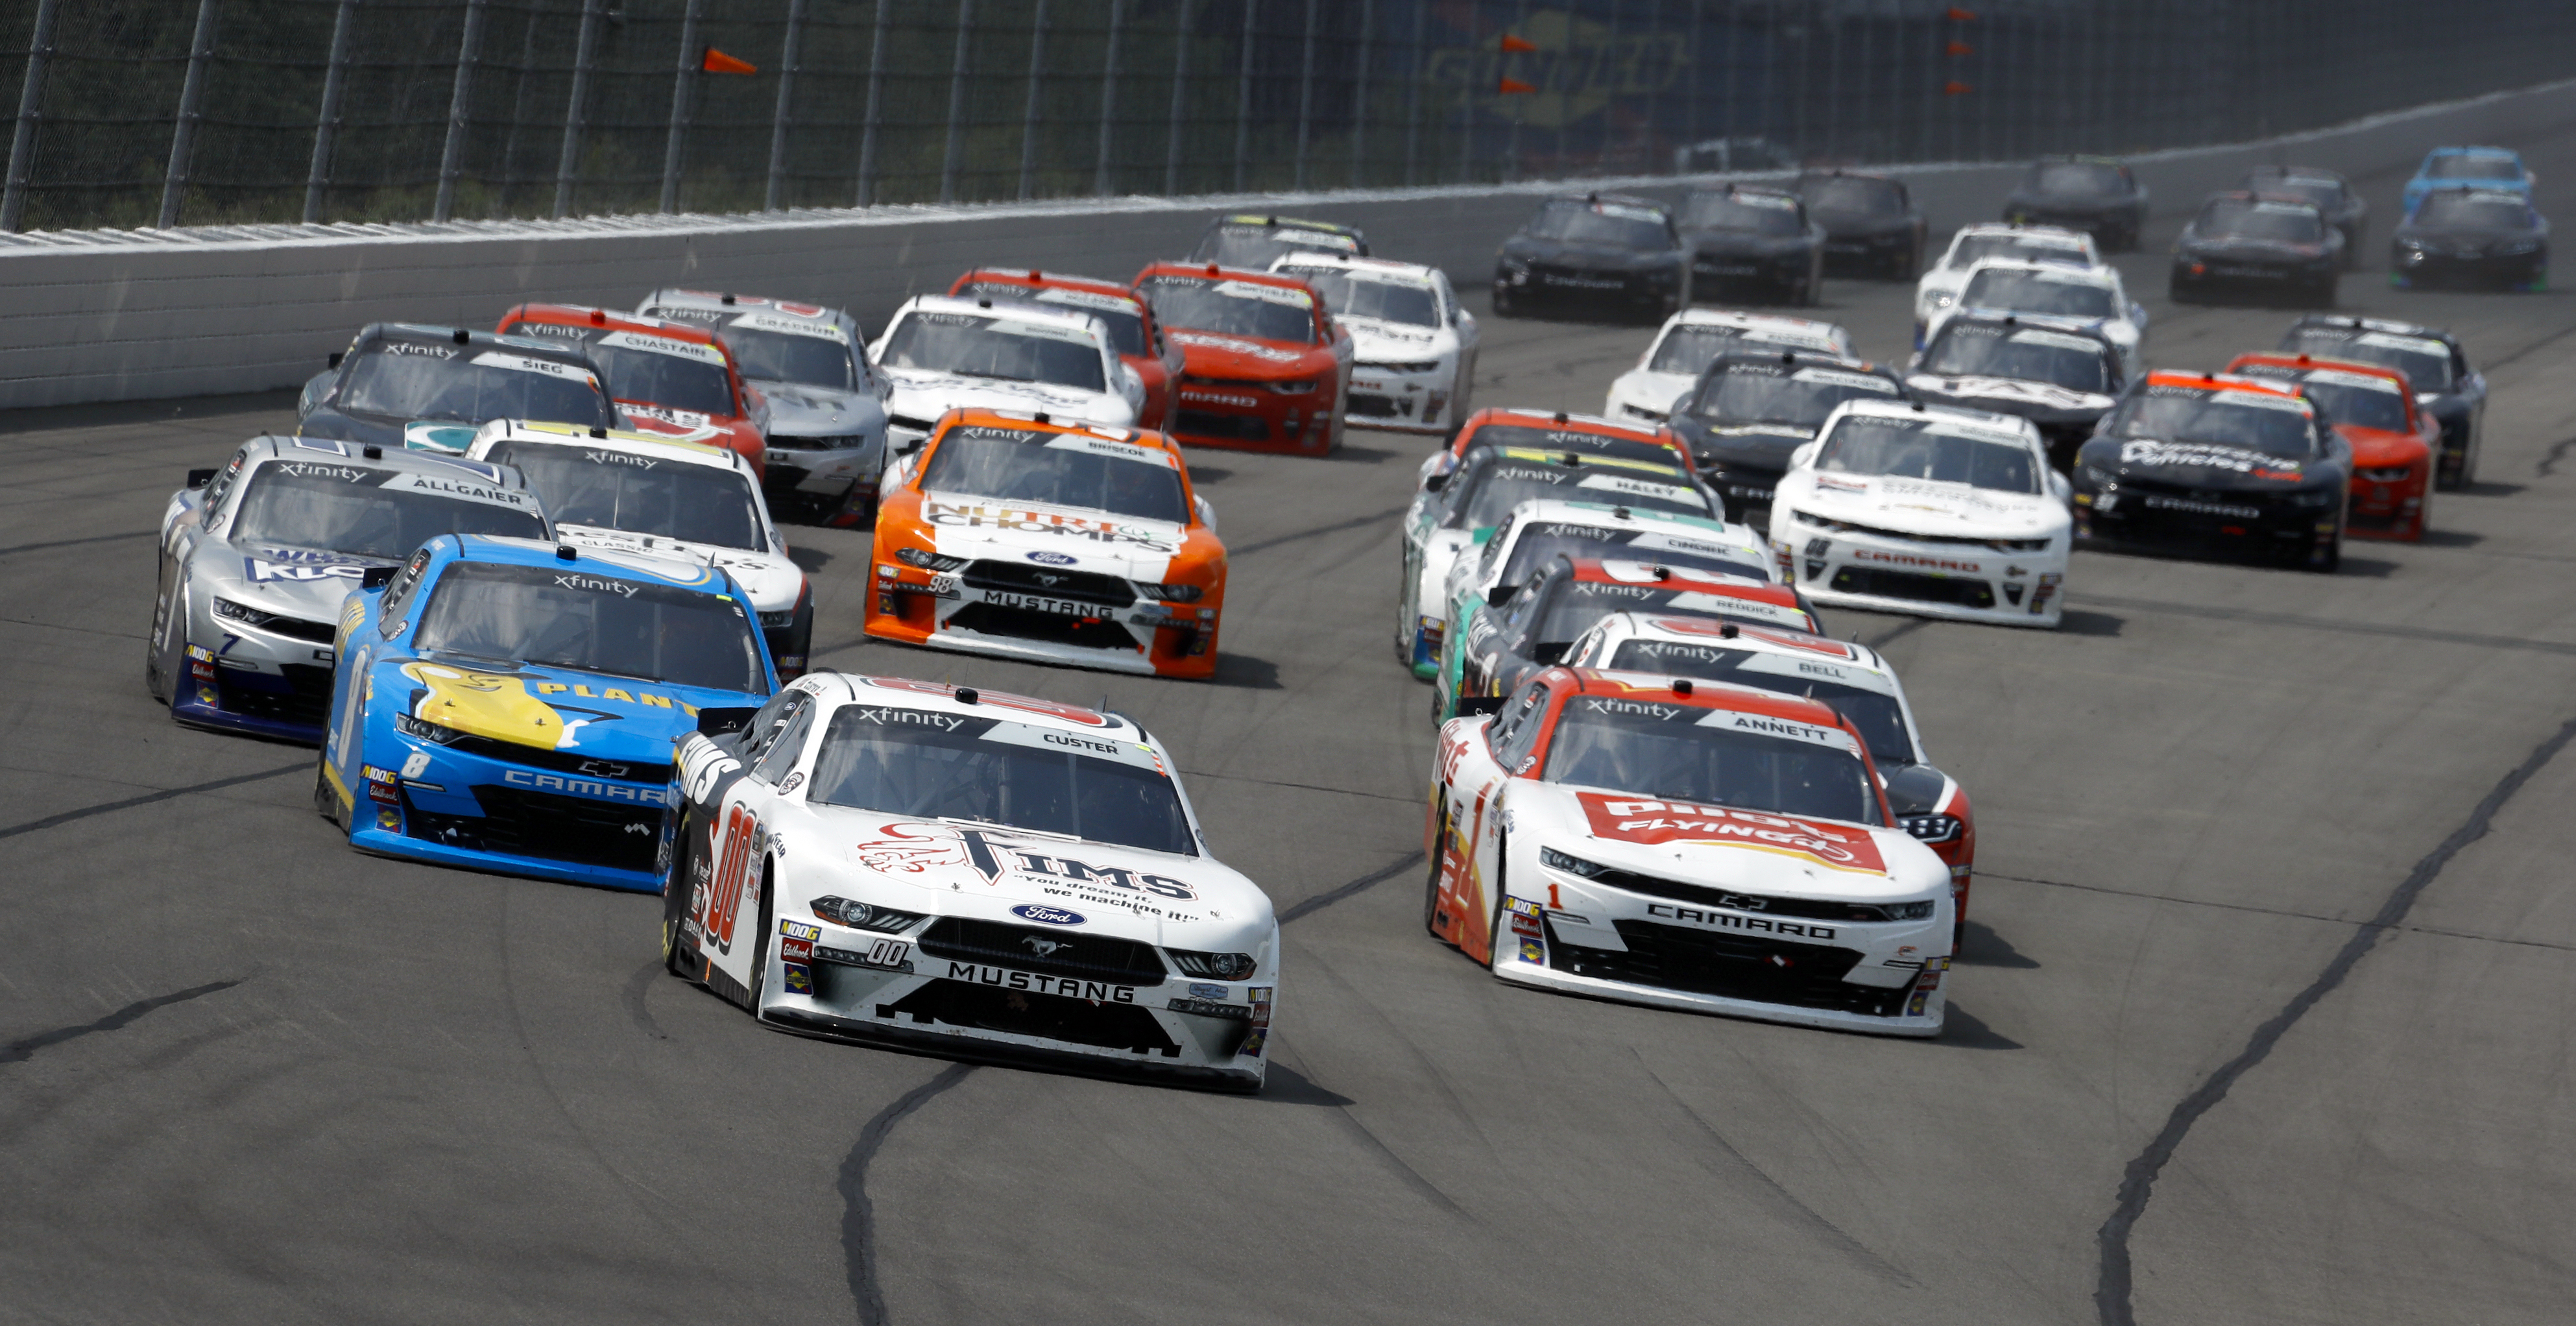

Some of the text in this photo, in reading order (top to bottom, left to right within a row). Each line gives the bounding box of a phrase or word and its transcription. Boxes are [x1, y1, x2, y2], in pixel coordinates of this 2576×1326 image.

[657, 307, 722, 322] xfinity
[520, 322, 707, 358] xfinity CHASTAIN
[385, 342, 563, 375] xfinity SIEG
[1181, 391, 1258, 407] MARO
[962, 426, 1146, 457] xfinity BRISCOE
[1545, 430, 1614, 449] xfinity
[585, 450, 658, 470] xfinity
[279, 462, 522, 506] xfinity ALLGAIER
[1494, 466, 1677, 497] xfinity HALEY
[1543, 522, 1617, 544] xfinity
[1853, 548, 1980, 573] CAMARO
[554, 573, 639, 599] xfinity
[927, 575, 954, 594] 98
[984, 590, 1114, 618] MUSTANG
[1573, 582, 1779, 616] xfinity REDDICK
[218, 633, 243, 656] 7
[1637, 642, 1847, 680] xfinity BELL
[858, 707, 1120, 756] xfinity CUSTER
[1585, 697, 1829, 741] xfinity ANNETT
[360, 764, 398, 785] MOOG
[400, 751, 433, 778] 8
[504, 769, 667, 804] CAMAR
[1043, 887, 1072, 897] we
[1079, 893, 1162, 916] machine
[1066, 882, 1128, 898] dream
[1548, 883, 1564, 910] 1
[1024, 904, 1072, 924] Ford
[1504, 897, 1541, 917] MOOG
[782, 921, 821, 941] MOOG
[1647, 902, 1836, 940] CAMARO
[783, 943, 810, 960] Edelbrock
[866, 938, 909, 967] 00
[786, 974, 810, 985] SUNOCO
[948, 961, 1135, 1004] MUSTANG
